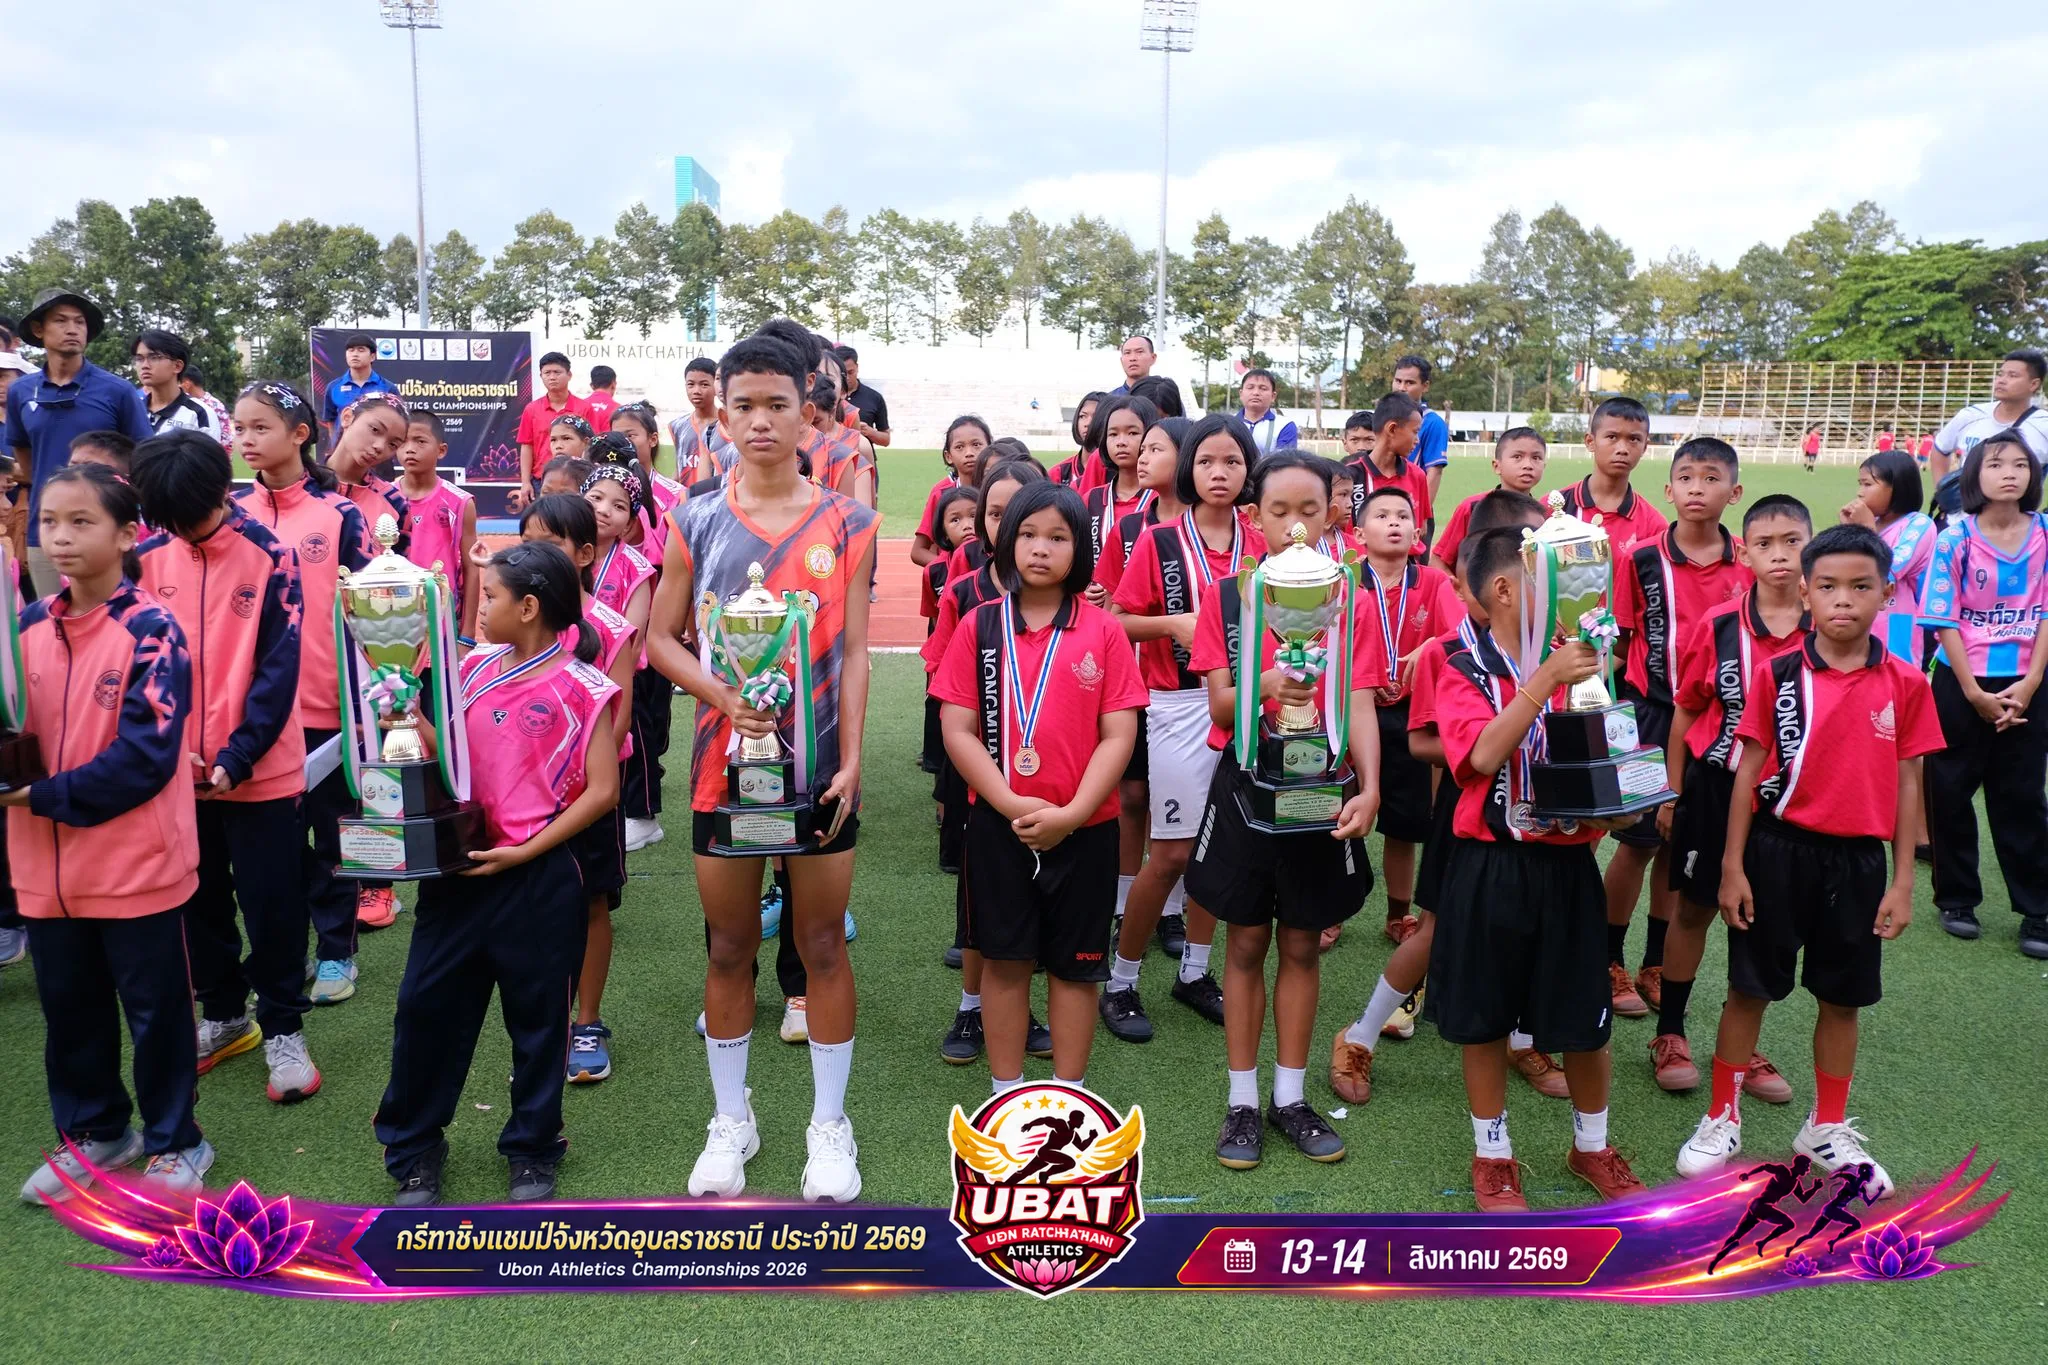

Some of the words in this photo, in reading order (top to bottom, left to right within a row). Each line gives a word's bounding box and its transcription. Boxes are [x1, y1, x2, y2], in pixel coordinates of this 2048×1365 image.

[566, 344, 610, 358] UBON
[617, 345, 706, 359] RATCHATHA
[432, 402, 508, 410] CHAMPIONSHIPS
[505, 489, 525, 515] 3
[1976, 569, 1988, 590] 9
[1164, 799, 1182, 824] 2
[1076, 952, 1104, 961] SPORT
